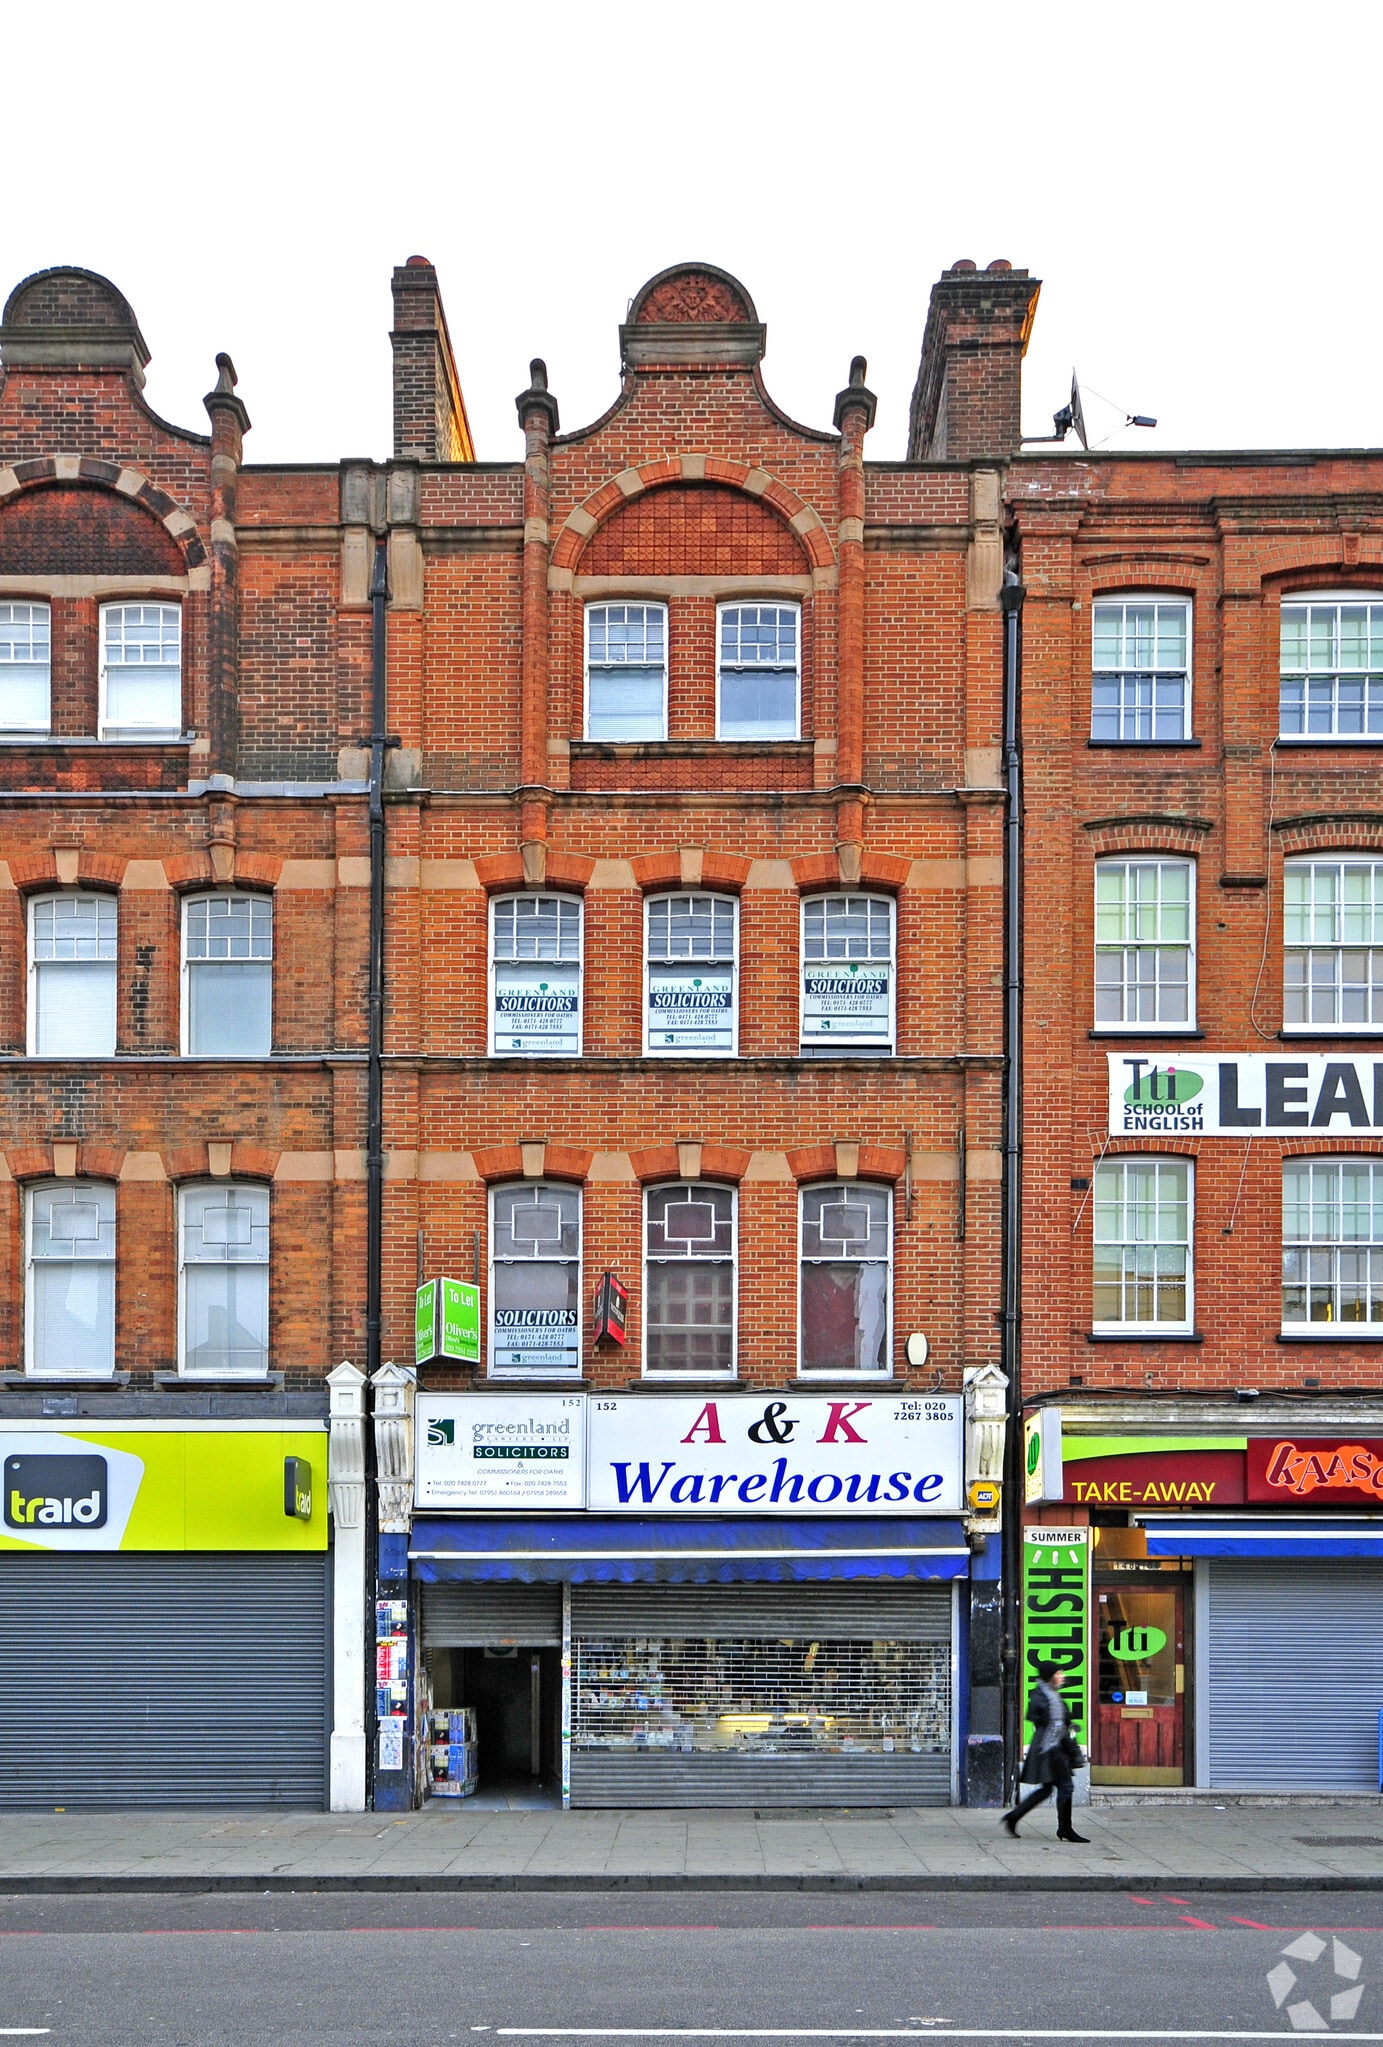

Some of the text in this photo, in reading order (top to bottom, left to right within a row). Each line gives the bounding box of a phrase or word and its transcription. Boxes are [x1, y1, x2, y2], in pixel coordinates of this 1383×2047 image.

[810, 980, 882, 993] SOLICITORS
[500, 997, 573, 1010] SOLICITORS
[654, 994, 726, 1007] SOLICITORS
[832, 1020, 873, 1029] greenland
[522, 1038, 563, 1048] greenland
[675, 1034, 716, 1043] greenland
[1123, 1059, 1179, 1101] Tti
[1219, 1062, 1383, 1127] LEA
[1124, 1103, 1204, 1116] SCHOOL of
[1124, 1117, 1204, 1130] ENGLISH
[448, 1288, 474, 1307] To Let
[495, 1310, 576, 1326] SOLICITORS
[446, 1322, 477, 1340] Oliver's
[522, 1354, 562, 1363] greenland
[596, 1403, 617, 1411] 152
[900, 1401, 946, 1411] Tel: 020
[680, 1402, 872, 1443] A & K
[894, 1412, 953, 1421] 7267 3805
[472, 1419, 569, 1442] greenland
[476, 1447, 567, 1457] SOLICITORS
[610, 1457, 944, 1503] Warehouse
[1071, 1482, 1216, 1502] TAKE-AWAY
[296, 1484, 311, 1515] traid
[11, 1490, 100, 1523] traid
[1031, 1532, 1081, 1542] SUMMER
[1108, 1621, 1148, 1652] Tti
